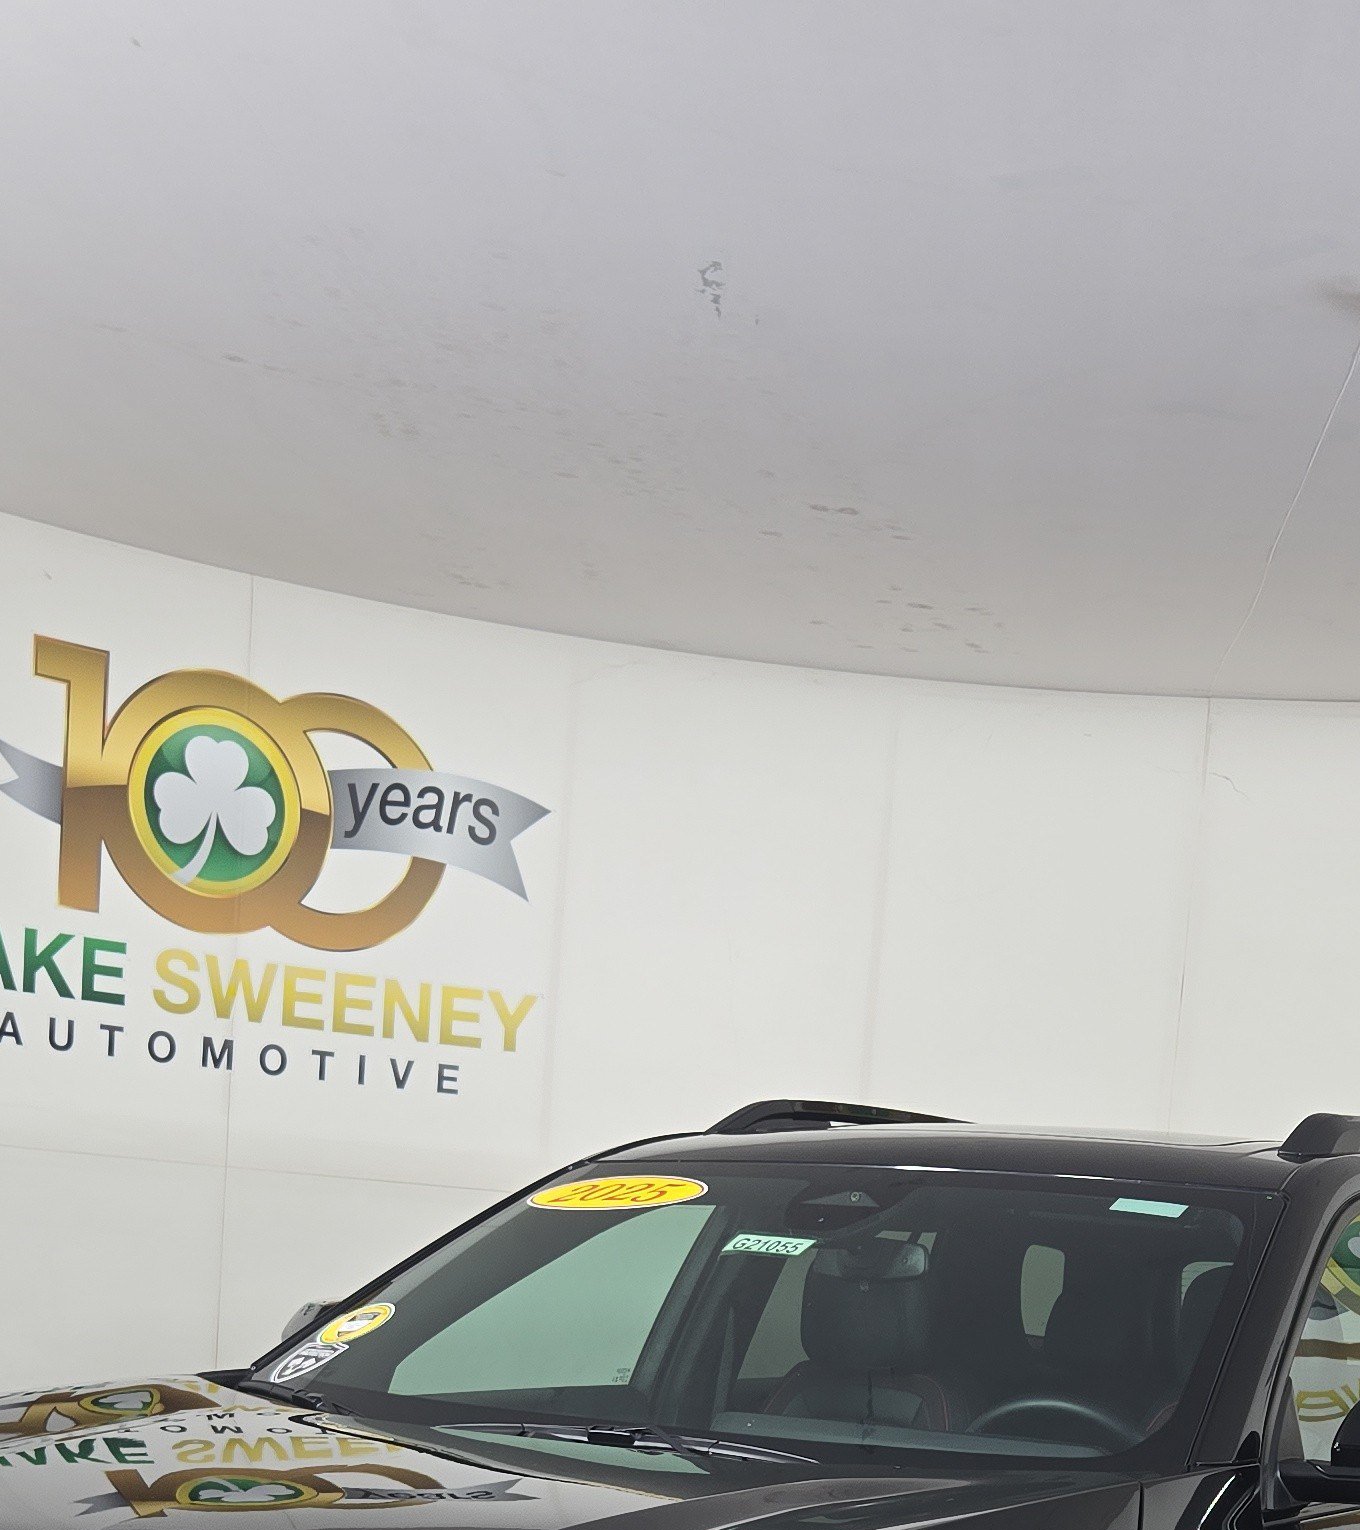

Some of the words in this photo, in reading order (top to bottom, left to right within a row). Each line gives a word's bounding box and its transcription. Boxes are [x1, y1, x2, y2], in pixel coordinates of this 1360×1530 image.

[31, 633, 448, 953] 100
[343, 779, 501, 846] years
[151, 948, 538, 1053] SWEENEY
[548, 1183, 686, 1203] 2025
[732, 1238, 804, 1254] G21055
